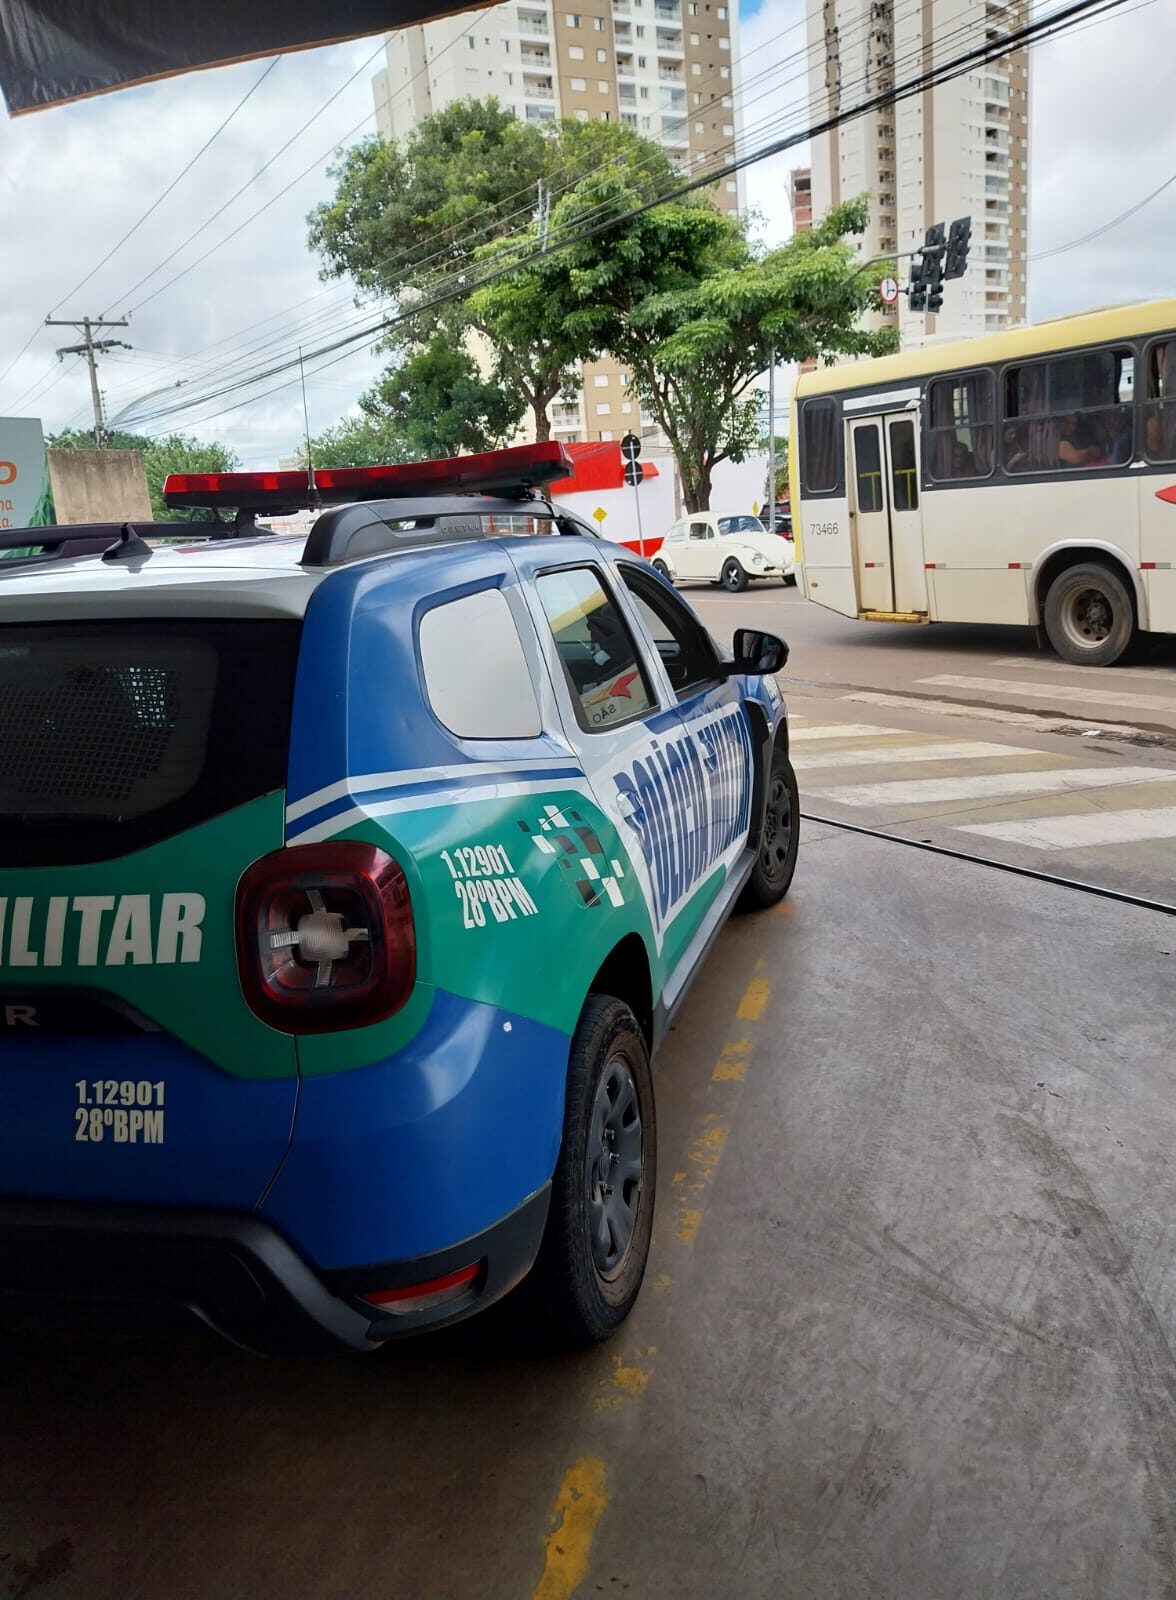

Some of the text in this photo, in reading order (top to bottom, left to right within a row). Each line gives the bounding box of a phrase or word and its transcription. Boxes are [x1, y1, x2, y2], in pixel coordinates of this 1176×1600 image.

[809, 523, 839, 536] 73466
[440, 843, 515, 879] 1.12901
[0, 892, 206, 967] LITAR
[75, 1079, 165, 1106] 1.12901
